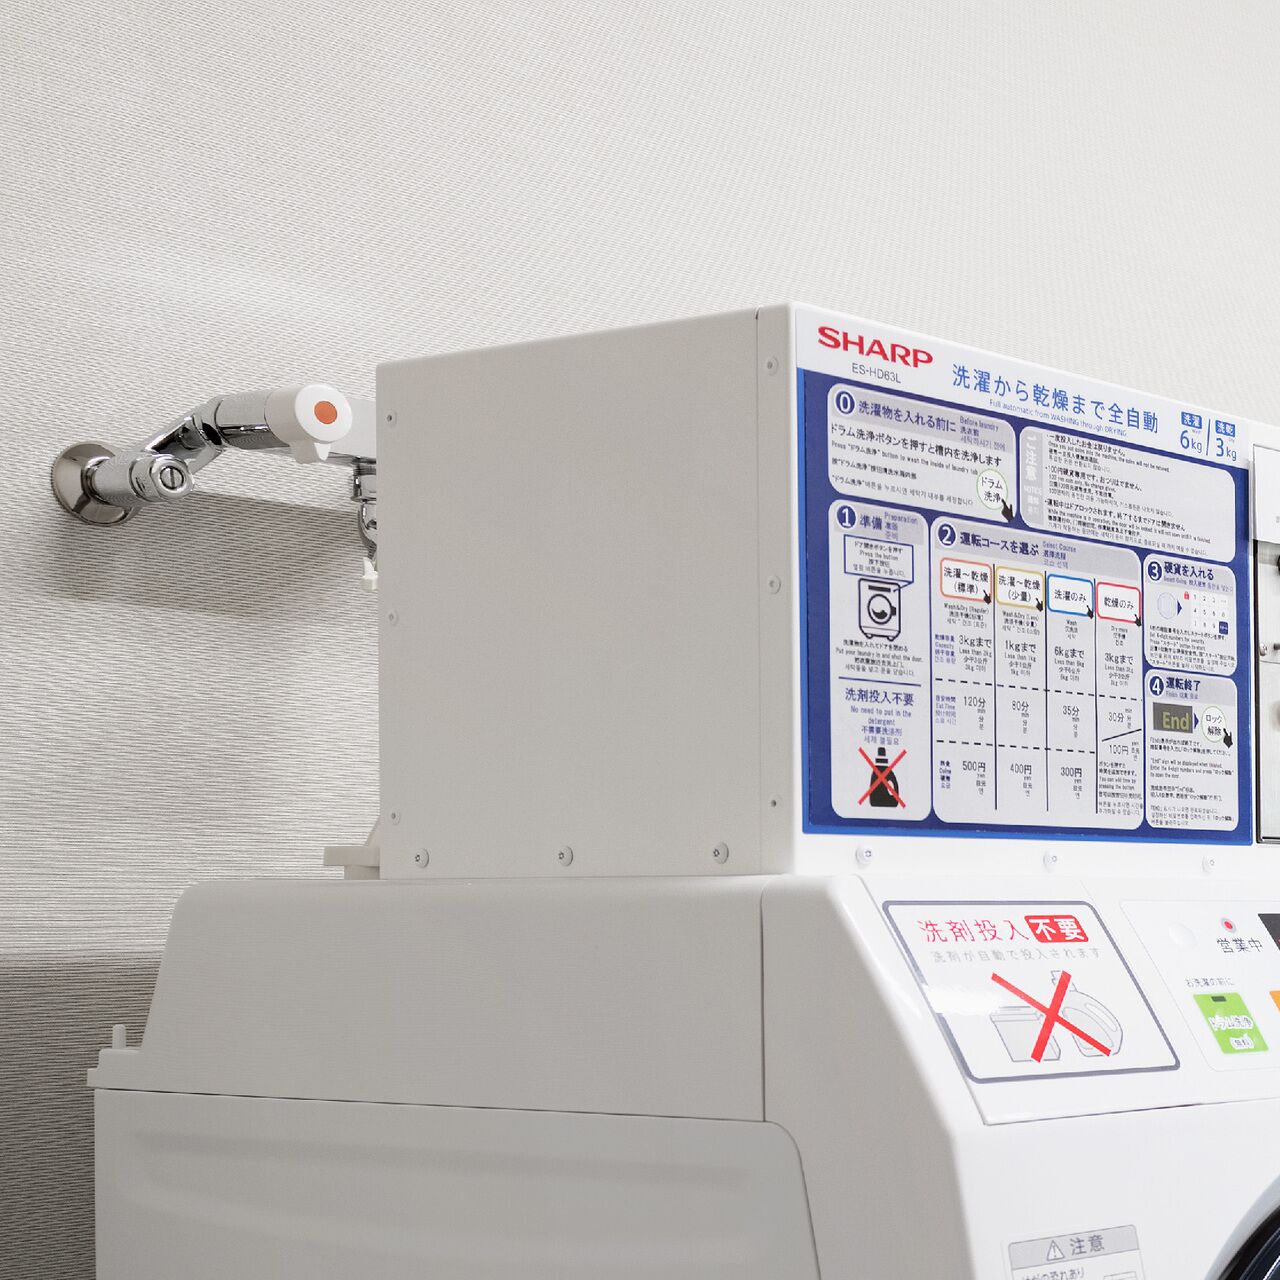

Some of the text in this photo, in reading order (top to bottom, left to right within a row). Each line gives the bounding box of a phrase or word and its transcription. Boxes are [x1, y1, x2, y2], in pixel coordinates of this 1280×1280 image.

[818, 326, 933, 368] SHARP
[852, 363, 901, 384] ES-HD63L
[952, 363, 1159, 434] 洗濯から乾燥まで全自動
[858, 400, 957, 433] 洗濯物を入れる前に
[960, 415, 978, 426] Before
[831, 422, 1002, 467] ドラム洗浄ボタンを押すと槽内を洗浄します
[1180, 429, 1237, 461] 6kg 3kg
[981, 476, 1003, 490] ドラム
[983, 490, 1002, 503] 洗浄
[860, 514, 883, 531] 準備
[884, 511, 918, 525] Preparation
[960, 532, 1040, 556] 運転コースを選ぶ
[1164, 562, 1214, 581] 硬貨を入れる
[953, 582, 979, 596] (標準)
[1008, 590, 1031, 602] (少量)
[1054, 588, 1087, 603] 洗濯のみ
[1103, 596, 1134, 610] 乾燥のみ
[959, 635, 992, 648] 3kgまで
[1005, 640, 1037, 653] 1kgまで
[1055, 646, 1084, 659] 6kgまで
[1105, 653, 1134, 665] 3kgまで
[1166, 676, 1201, 692] 運転終了
[845, 688, 914, 706] 洗剤投入不要
[963, 696, 986, 708] 120分
[1011, 700, 1029, 712] 80分
[1062, 705, 1080, 716] 35分
[1108, 712, 1124, 723] 30分
[1162, 711, 1190, 730] End
[1205, 714, 1223, 724] ロック
[1207, 727, 1222, 737] 解除
[1109, 744, 1129, 755] 100円
[962, 760, 986, 772] 500円
[1010, 764, 1032, 775] 400円
[1060, 766, 1083, 778] 300円
[917, 917, 1086, 943] 洗剤投入不要
[1216, 936, 1264, 954] 営業中
[932, 947, 1099, 963] 洗剤が自動で投入されます
[1069, 1234, 1105, 1256] 注意
